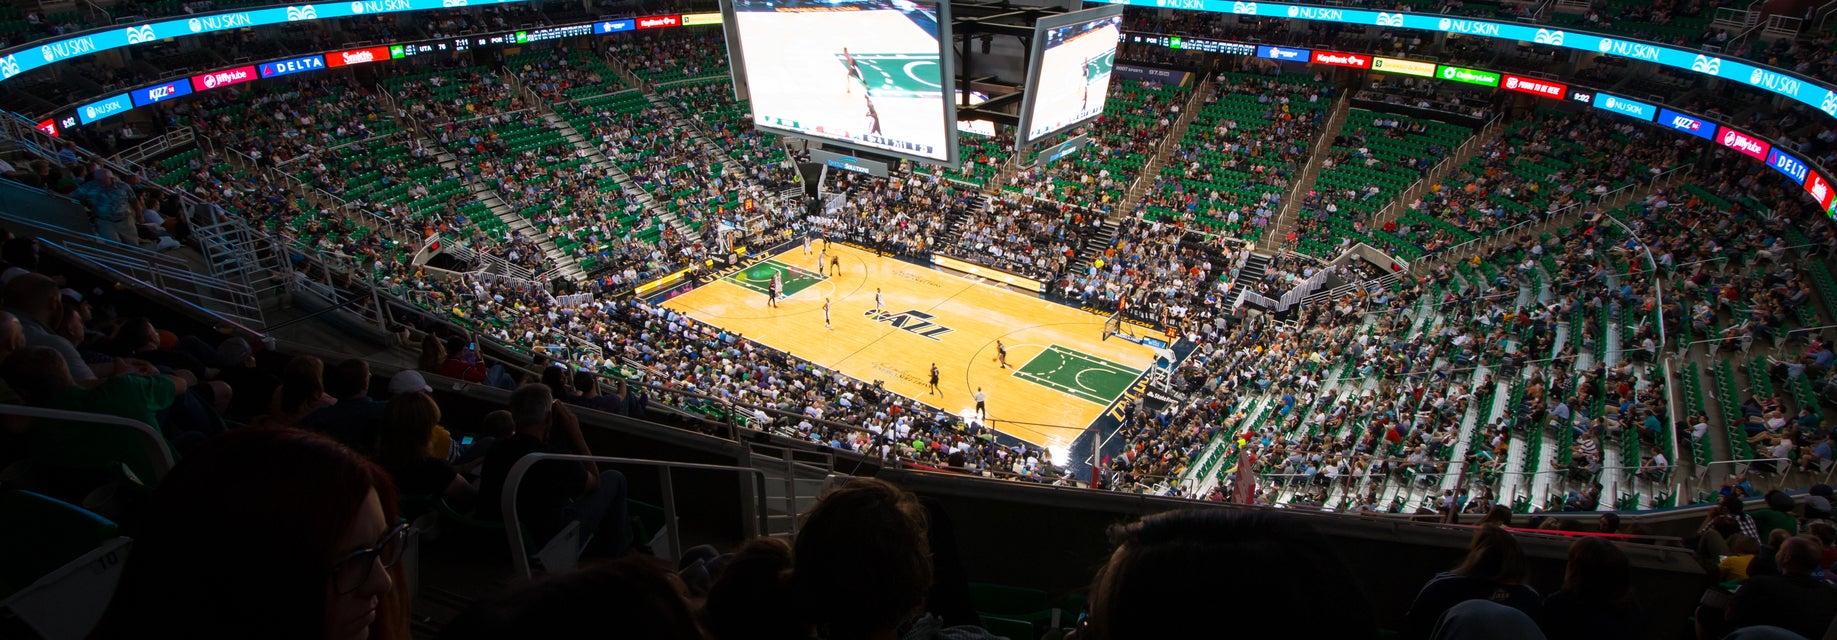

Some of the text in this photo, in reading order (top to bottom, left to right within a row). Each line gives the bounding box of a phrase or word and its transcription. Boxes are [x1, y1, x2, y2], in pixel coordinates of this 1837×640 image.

[366, 0, 410, 12] NU SKIN
[1299, 8, 1342, 21] NU SKIN
[202, 13, 250, 31] NU SKIN
[1452, 21, 1498, 35] NU SKIN
[52, 38, 95, 59] NU SKIN
[1612, 41, 1659, 60] NU SKIN
[277, 58, 322, 73] DELTA
[1317, 54, 1347, 65] KeyBank
[1455, 71, 1495, 83] CenturyLink
[1518, 80, 1534, 90] PROUD
[1534, 83, 1541, 91] TO
[1541, 84, 1547, 92] BE
[1761, 73, 1801, 96] NU SKIN
[149, 86, 168, 101] KJZZ
[1574, 92, 1591, 103] 9:02
[96, 101, 121, 114] NU SKIN
[1615, 101, 1642, 115] NU SKIN
[62, 116, 76, 128] 9:02
[1672, 116, 1692, 129] KJZZ
[1777, 155, 1806, 182] DELTA
[699, 265, 741, 283] UTAH
[740, 251, 775, 268] JAZZ
[99, 552, 117, 570] 10
